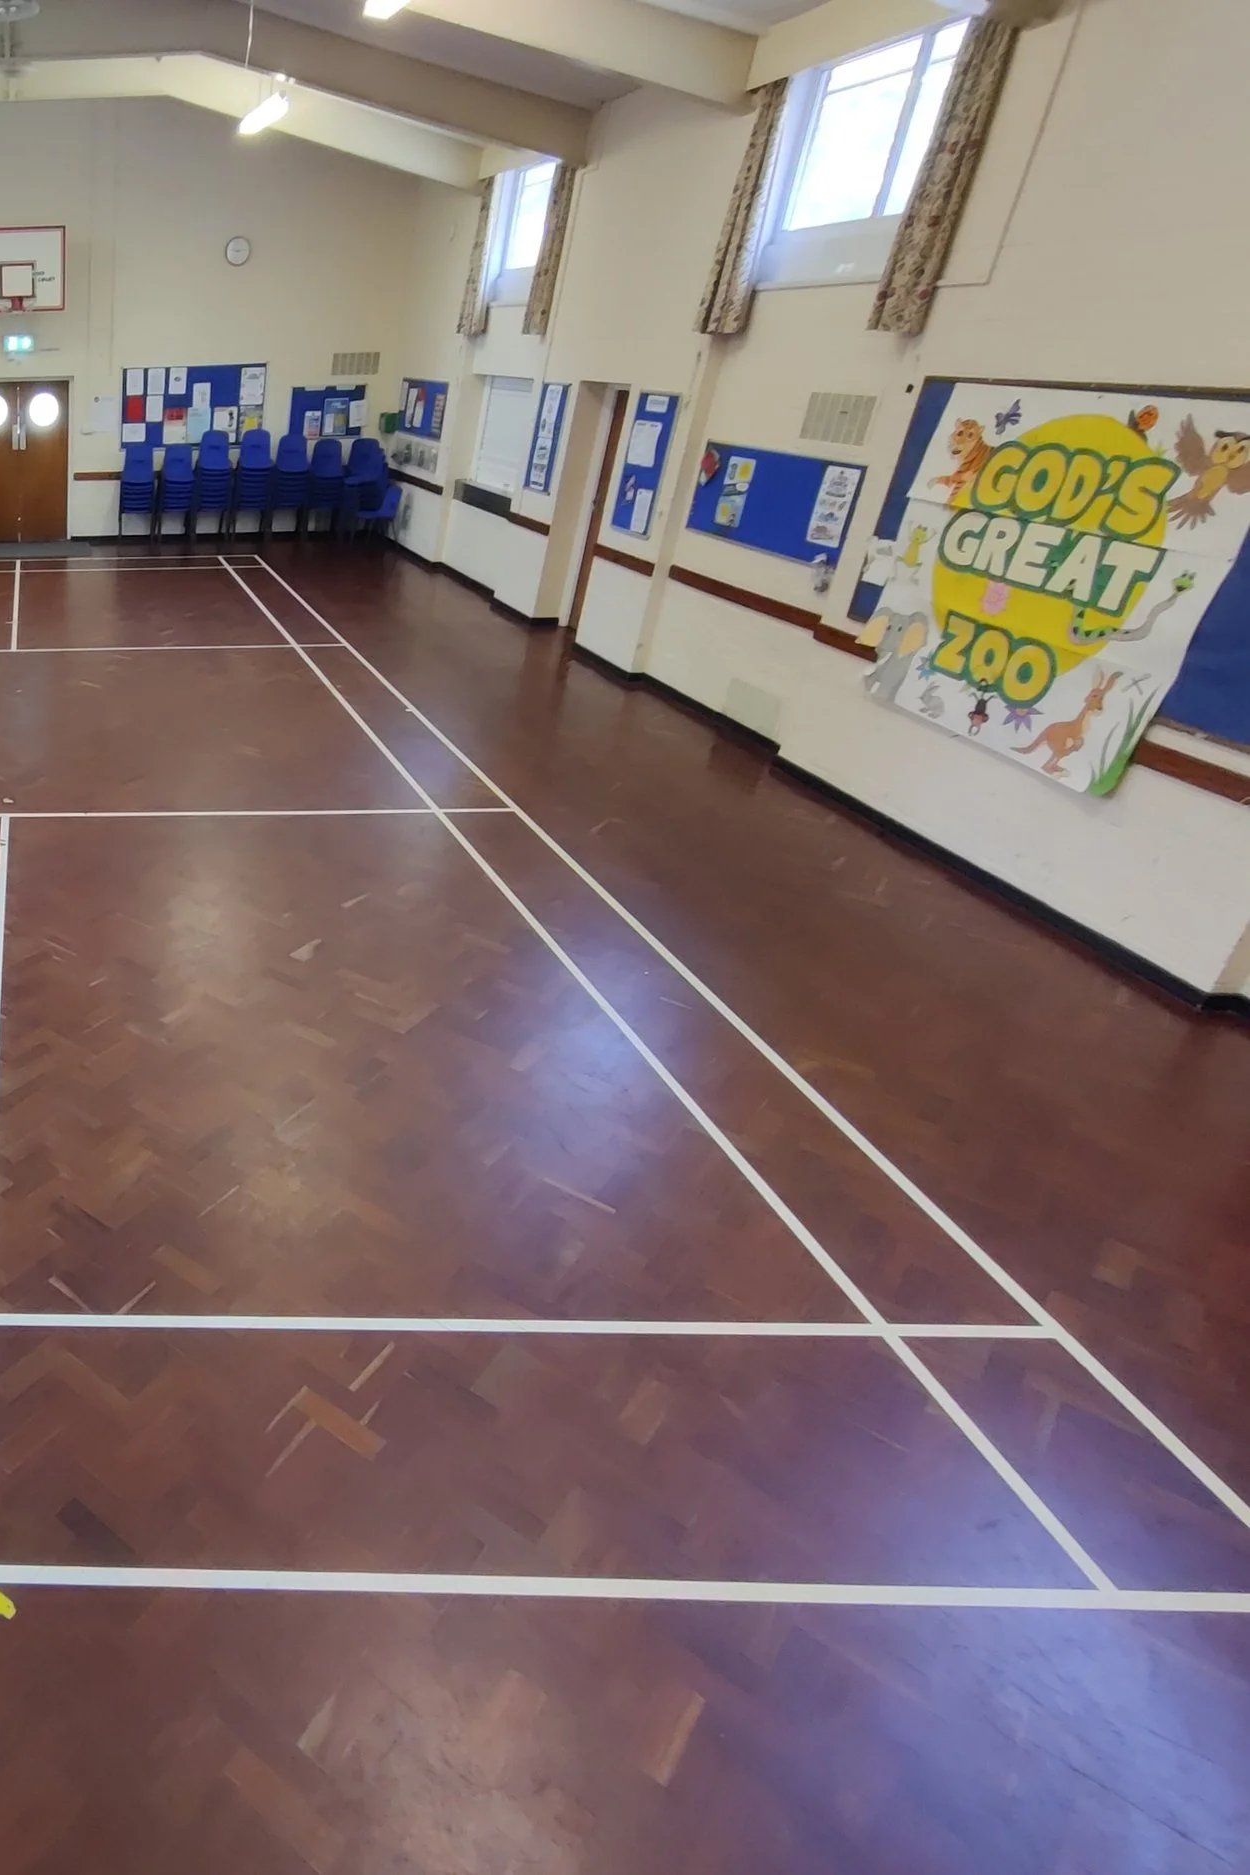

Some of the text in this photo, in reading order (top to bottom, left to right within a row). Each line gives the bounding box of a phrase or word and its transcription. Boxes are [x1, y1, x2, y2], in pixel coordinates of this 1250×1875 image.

[972, 442, 1180, 538] GOD'S
[939, 510, 1164, 614] GREAT
[932, 611, 1055, 706] ZOO
